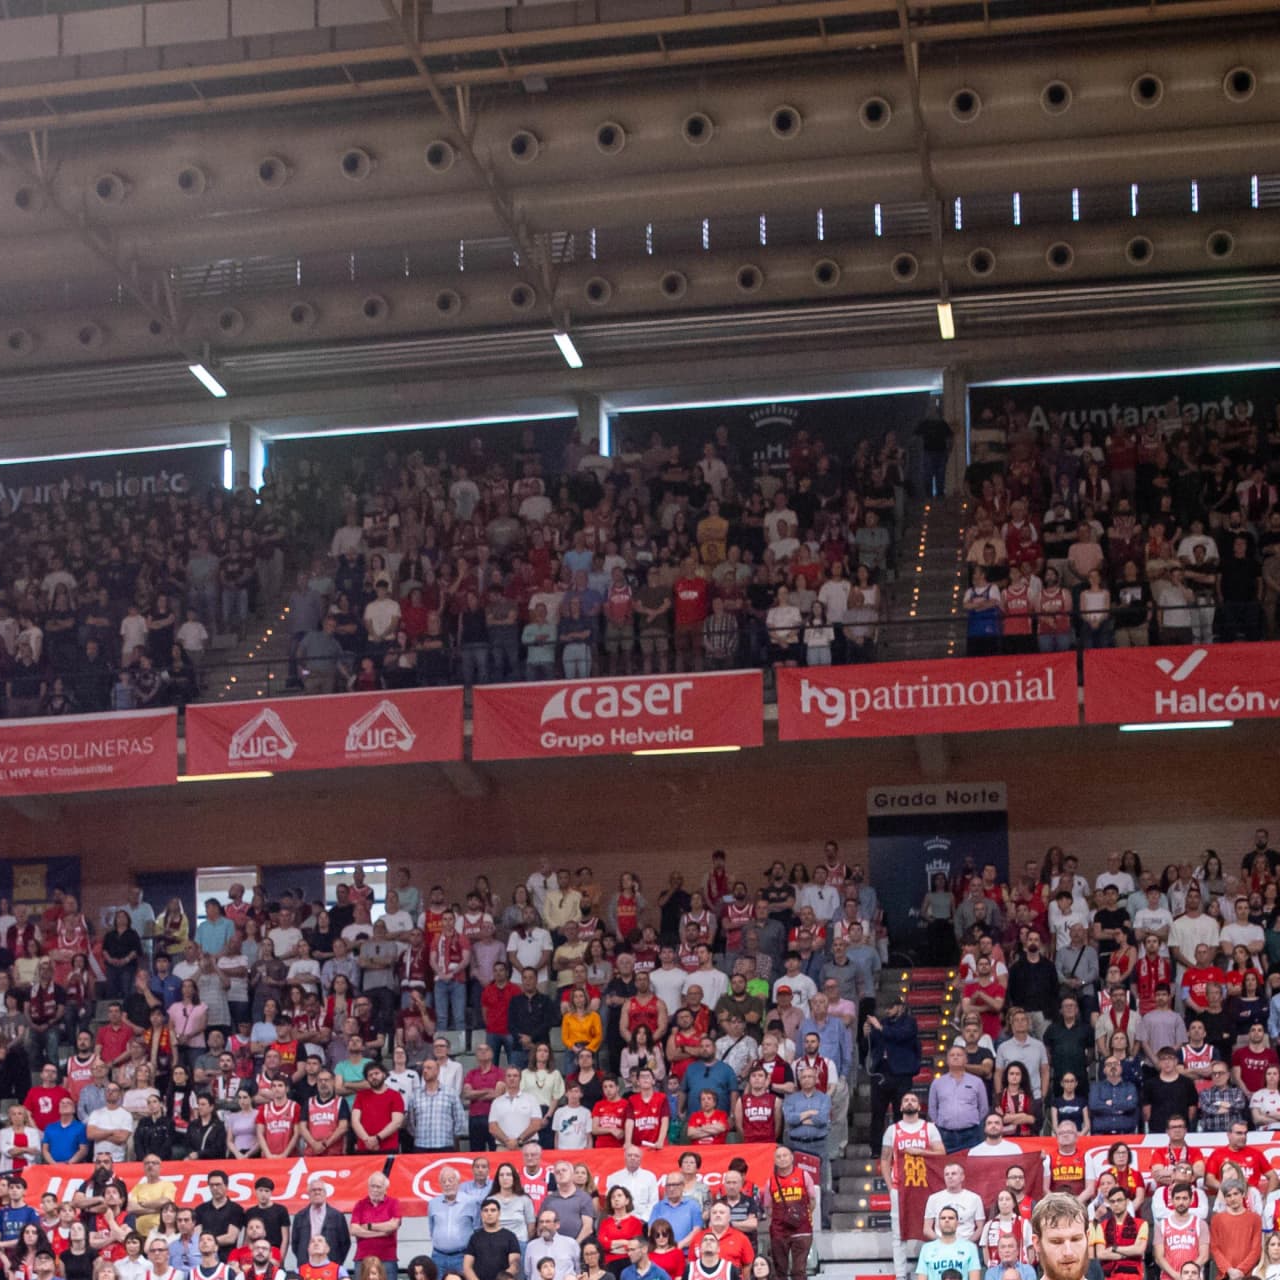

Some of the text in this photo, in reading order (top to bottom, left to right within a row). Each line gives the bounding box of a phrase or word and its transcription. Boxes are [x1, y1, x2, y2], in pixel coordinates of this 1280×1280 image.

[571, 681, 693, 719] caser
[1154, 686, 1265, 716] Halcón
[23, 736, 154, 762] GASOLINERAS
[540, 725, 694, 752] Grupo Helvetia
[874, 788, 1000, 808] Grada Norte
